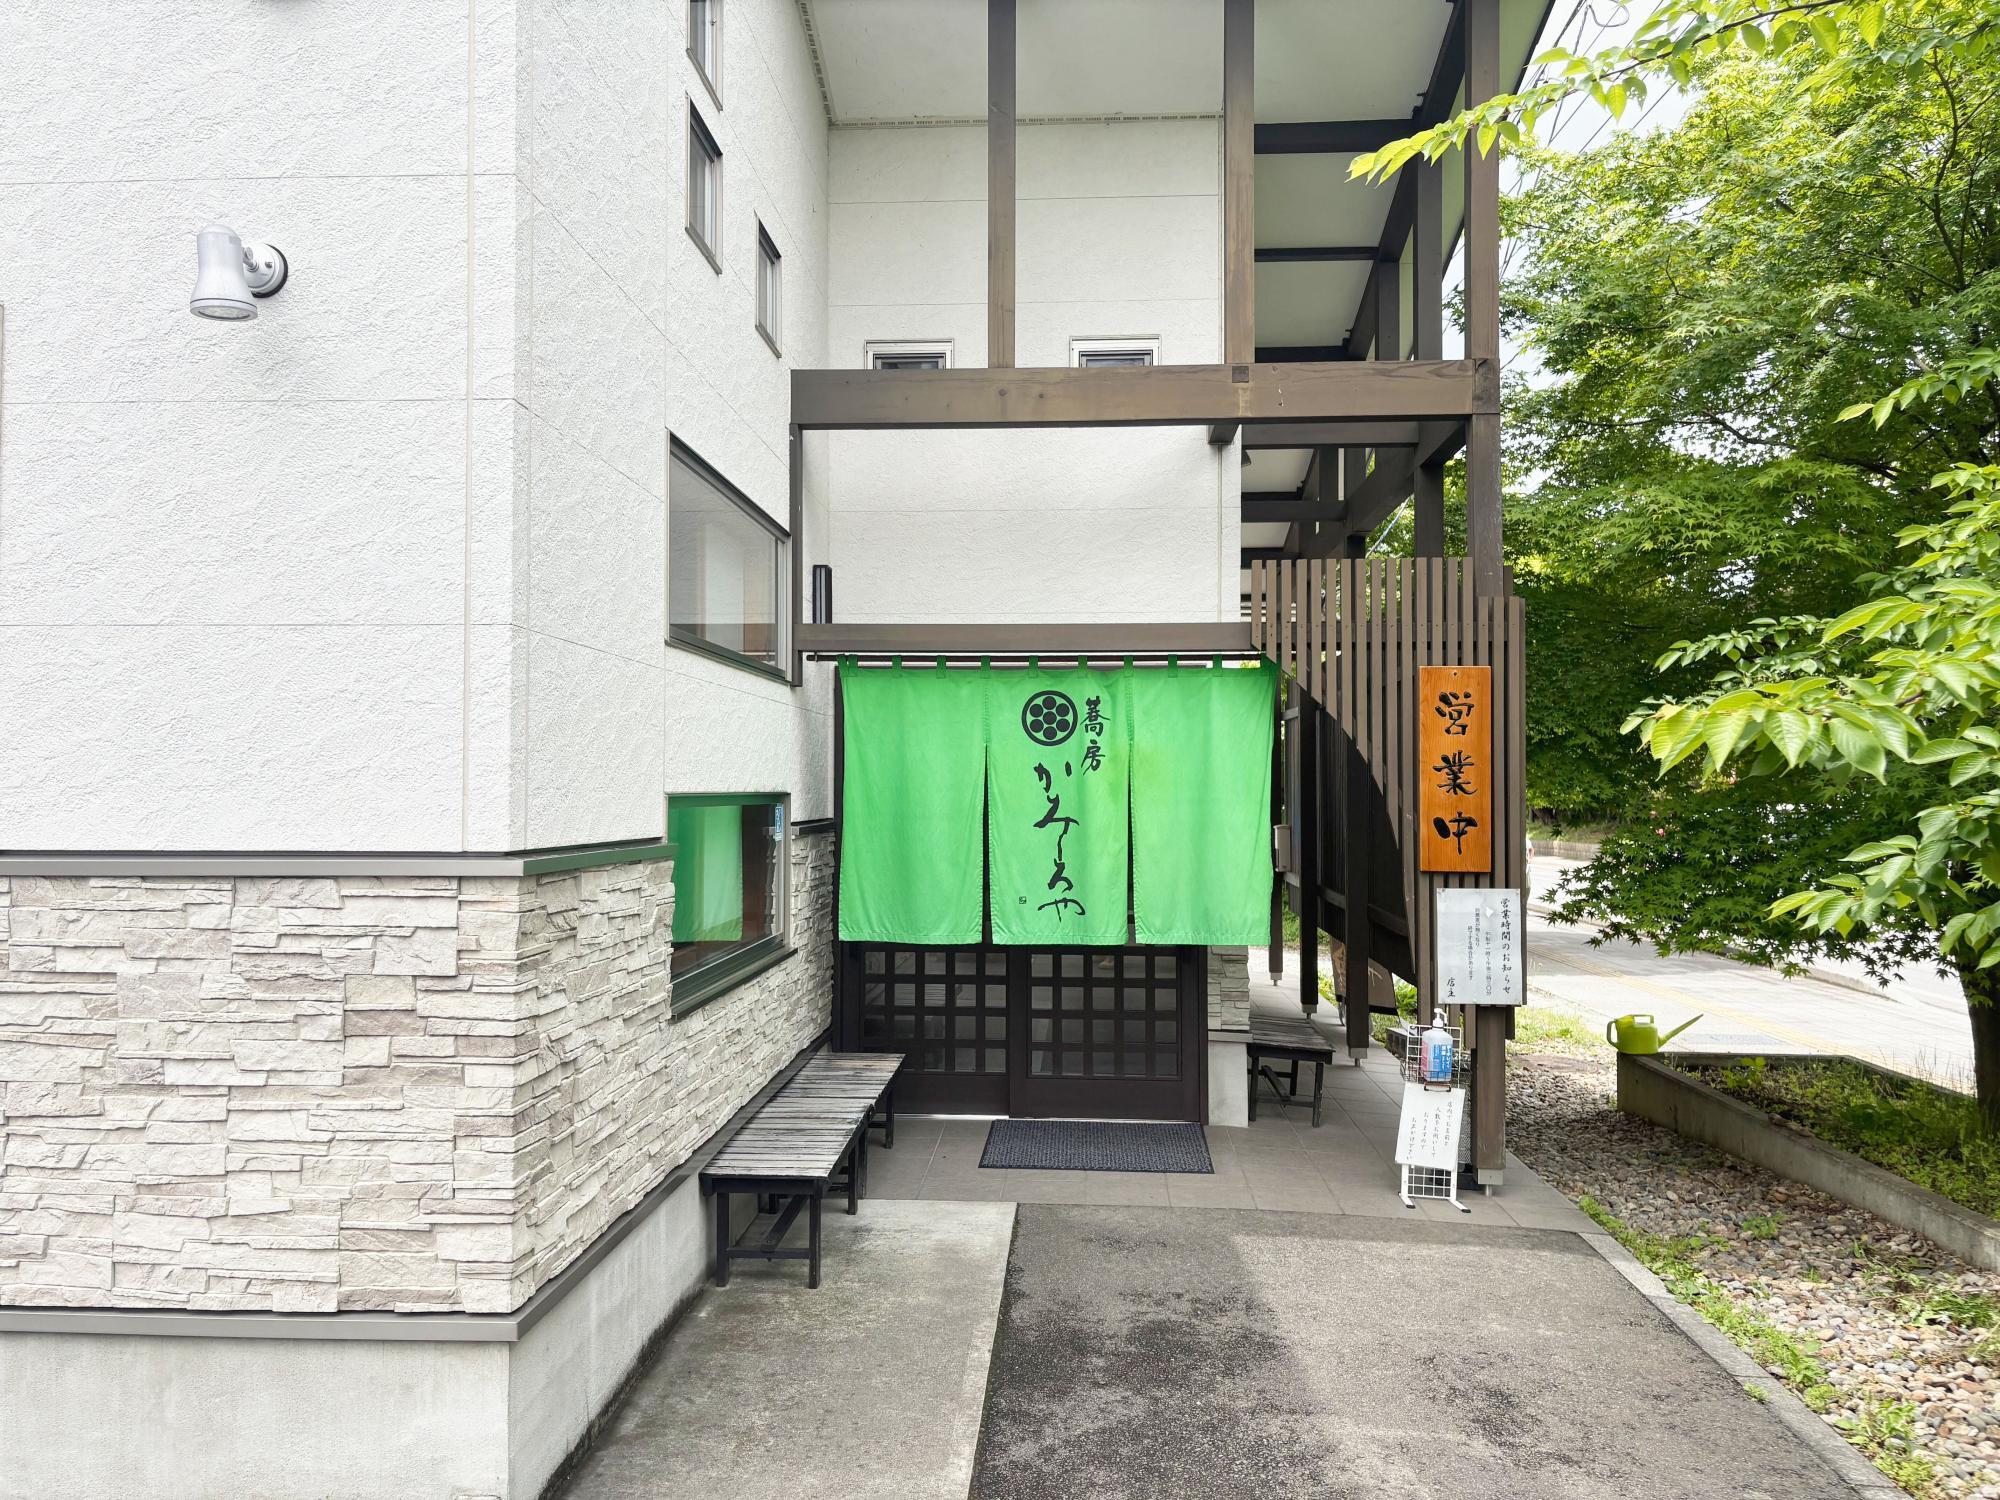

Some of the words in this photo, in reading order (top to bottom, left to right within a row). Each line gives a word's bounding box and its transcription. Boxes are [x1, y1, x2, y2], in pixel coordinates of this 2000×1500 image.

[1080, 695, 1110, 776] 蕎房
[1432, 691, 1478, 855] 営業中
[1446, 976, 1456, 998] 店主
[1500, 898, 1512, 994] 営業時間のお知らせ
